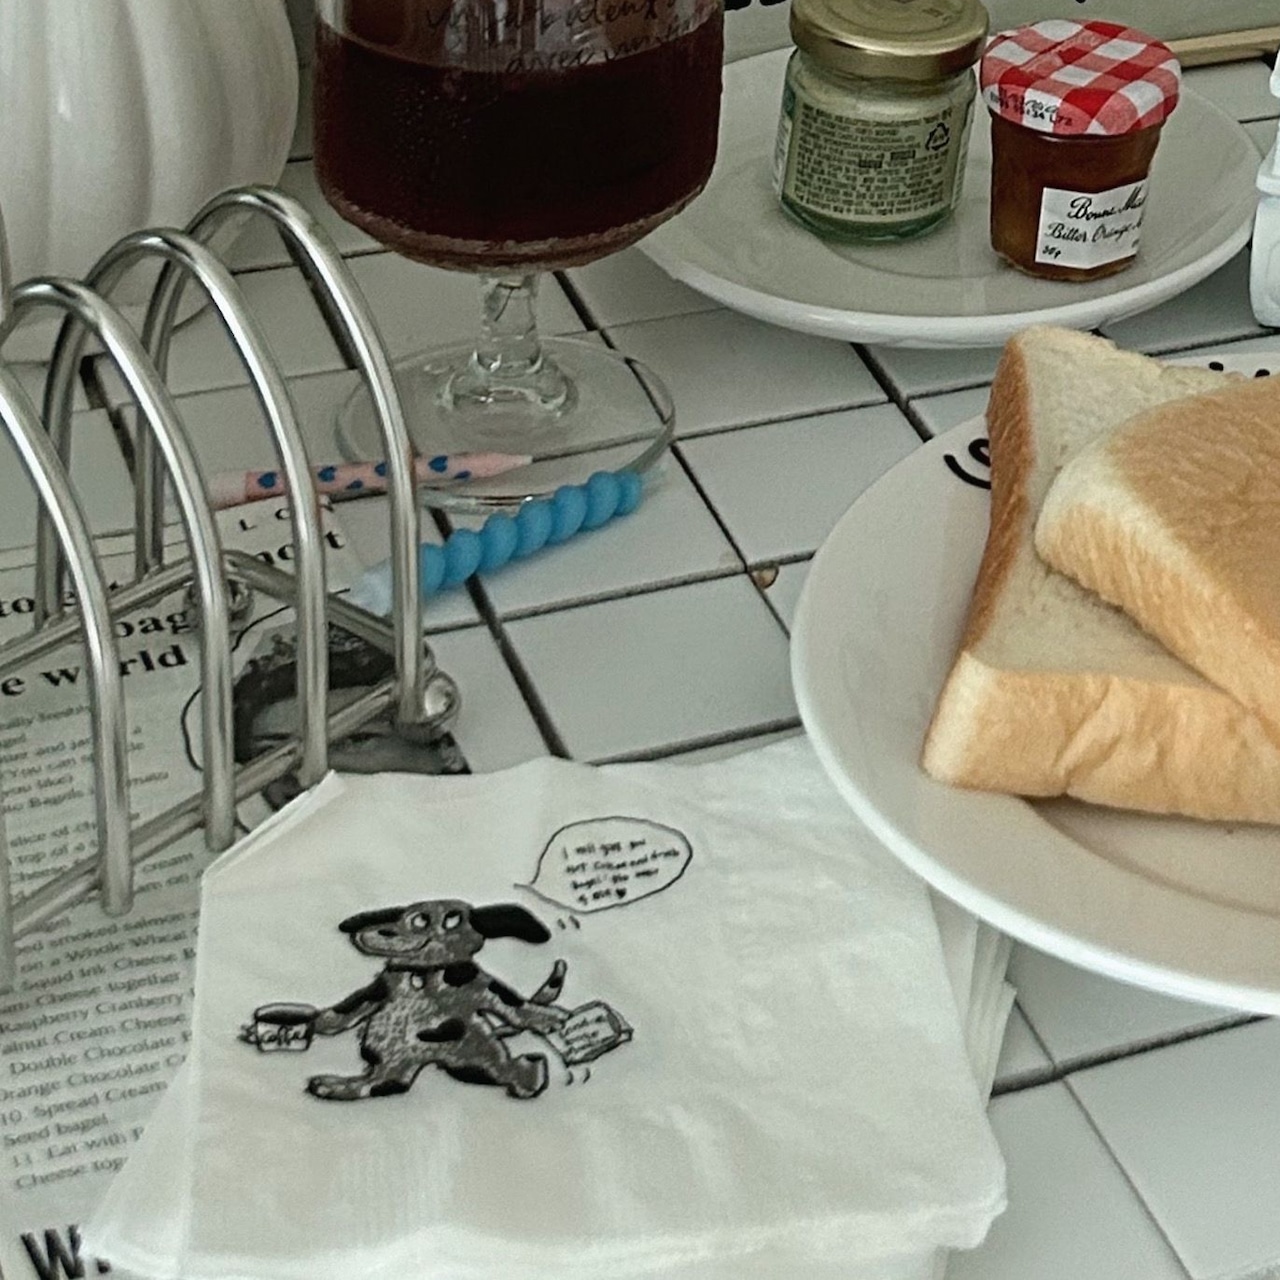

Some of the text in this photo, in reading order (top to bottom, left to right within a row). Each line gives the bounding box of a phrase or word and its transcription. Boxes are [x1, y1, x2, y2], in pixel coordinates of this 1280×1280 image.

[40, 644, 189, 688] wrld
[36, 985, 102, 1006] Cheese
[95, 992, 184, 1015] Cranberry
[54, 1024, 117, 1045] Cream
[120, 1013, 187, 1032] Cheese
[10, 1036, 176, 1075] Double Chocolate
[67, 1062, 161, 1087] Chocolate
[33, 1092, 100, 1119] Spread
[105, 1080, 169, 1102] Cream
[3, 1112, 109, 1148] Seed bagel
[84, 1132, 129, 1151] with
[15, 1164, 87, 1190] Cheese
